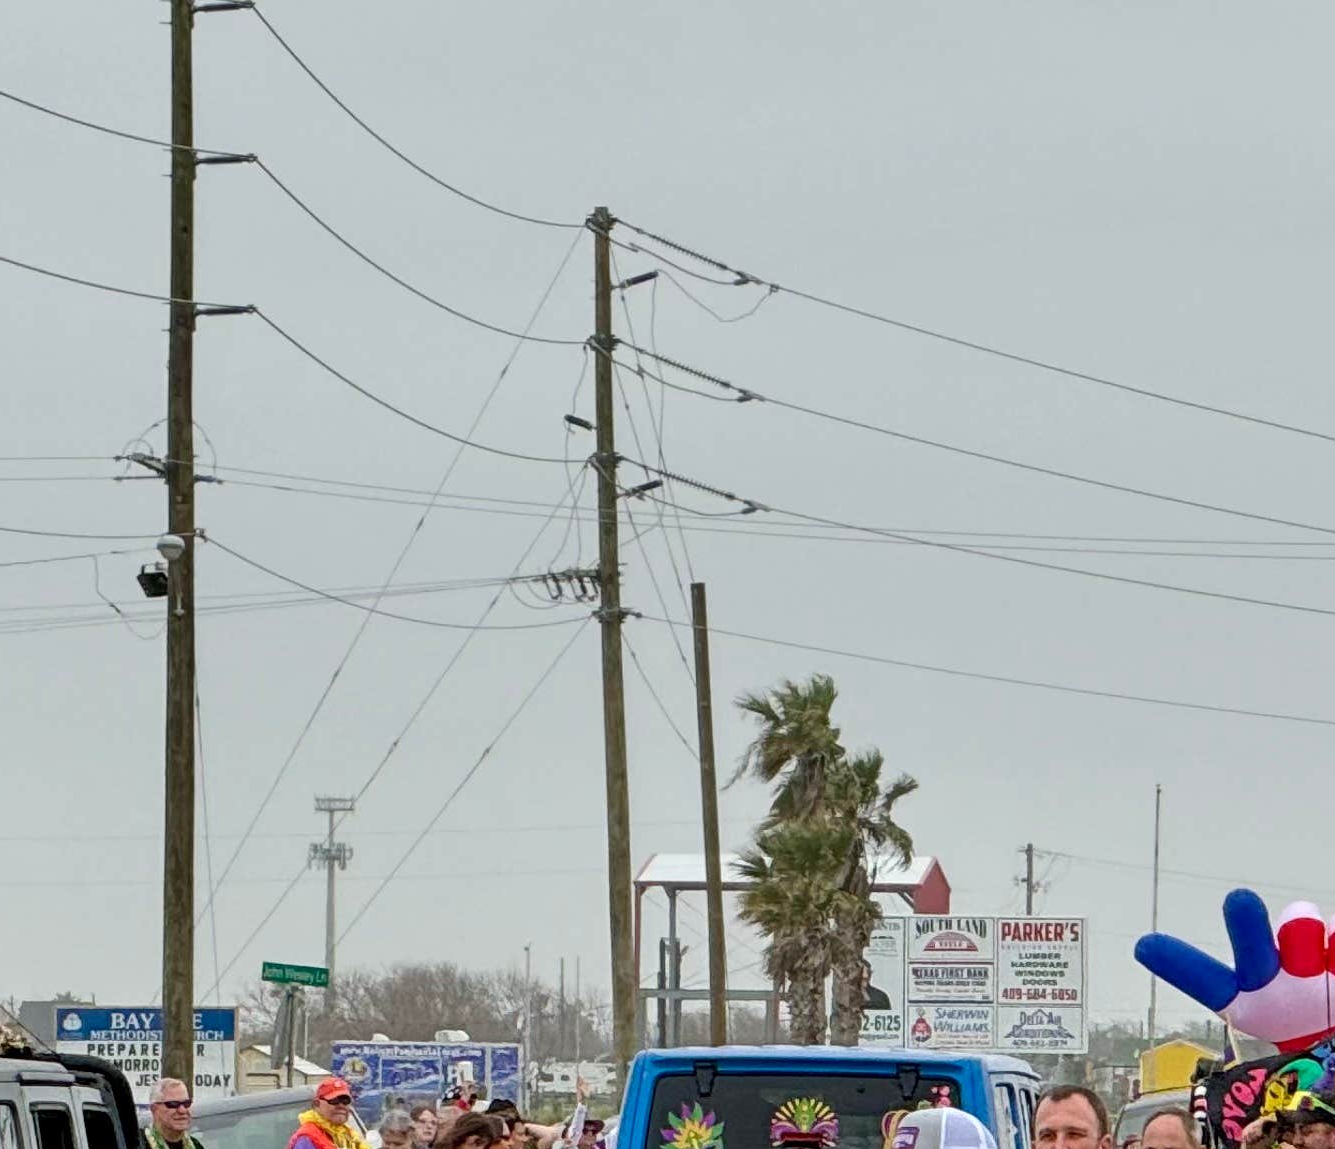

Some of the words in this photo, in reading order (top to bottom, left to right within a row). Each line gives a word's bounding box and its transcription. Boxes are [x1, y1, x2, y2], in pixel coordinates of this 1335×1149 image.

[915, 919, 953, 939] SOUTH
[957, 919, 987, 939] LAND
[1001, 922, 1080, 942] PARKER'S
[1019, 952, 1061, 960] LUMBER
[1011, 961, 1069, 969] HARDWARE
[1015, 970, 1065, 978] WINDOWS
[935, 1007, 989, 1020] SHERWIN
[110, 1013, 155, 1030] BAY
[89, 1030, 163, 1041] METHODIST
[196, 1030, 224, 1041] RCH
[87, 1044, 160, 1057] PREPARE
[195, 1074, 232, 1087] ODAY
